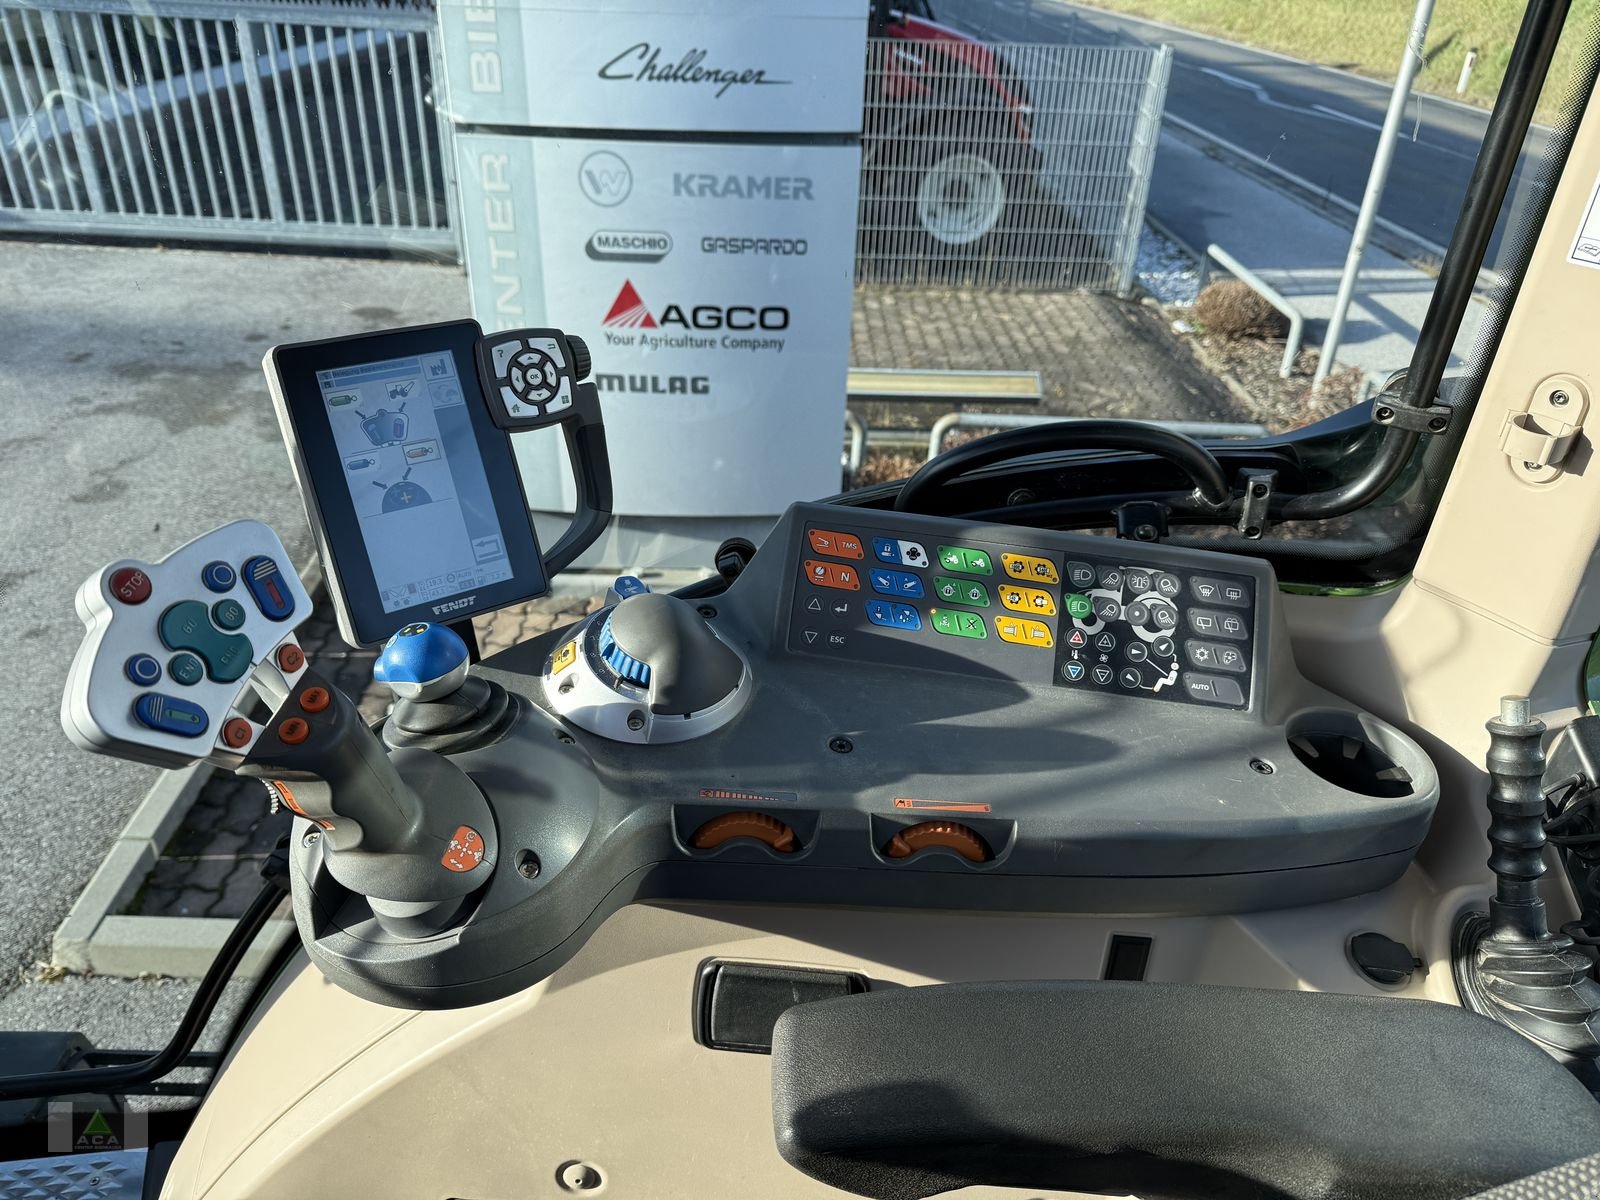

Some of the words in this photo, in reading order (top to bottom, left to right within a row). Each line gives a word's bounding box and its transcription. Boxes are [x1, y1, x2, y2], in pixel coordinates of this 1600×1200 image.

[598, 42, 792, 98] Challenger
[673, 172, 814, 201] KRAMER
[597, 235, 668, 251] MASCHIO
[701, 236, 808, 256] GASPARDO
[660, 304, 790, 331] AGCO
[605, 331, 634, 346] Your
[639, 333, 717, 351] Agriculture
[721, 334, 785, 353] Company
[596, 373, 711, 395] MULAG
[842, 541, 857, 550] TMS
[120, 570, 145, 598] STOP
[841, 572, 850, 582] N
[225, 606, 239, 621] GO
[432, 596, 476, 615] FENDT
[830, 635, 845, 644] ESC
[179, 657, 199, 679] END
[1191, 682, 1210, 692] AUTO
